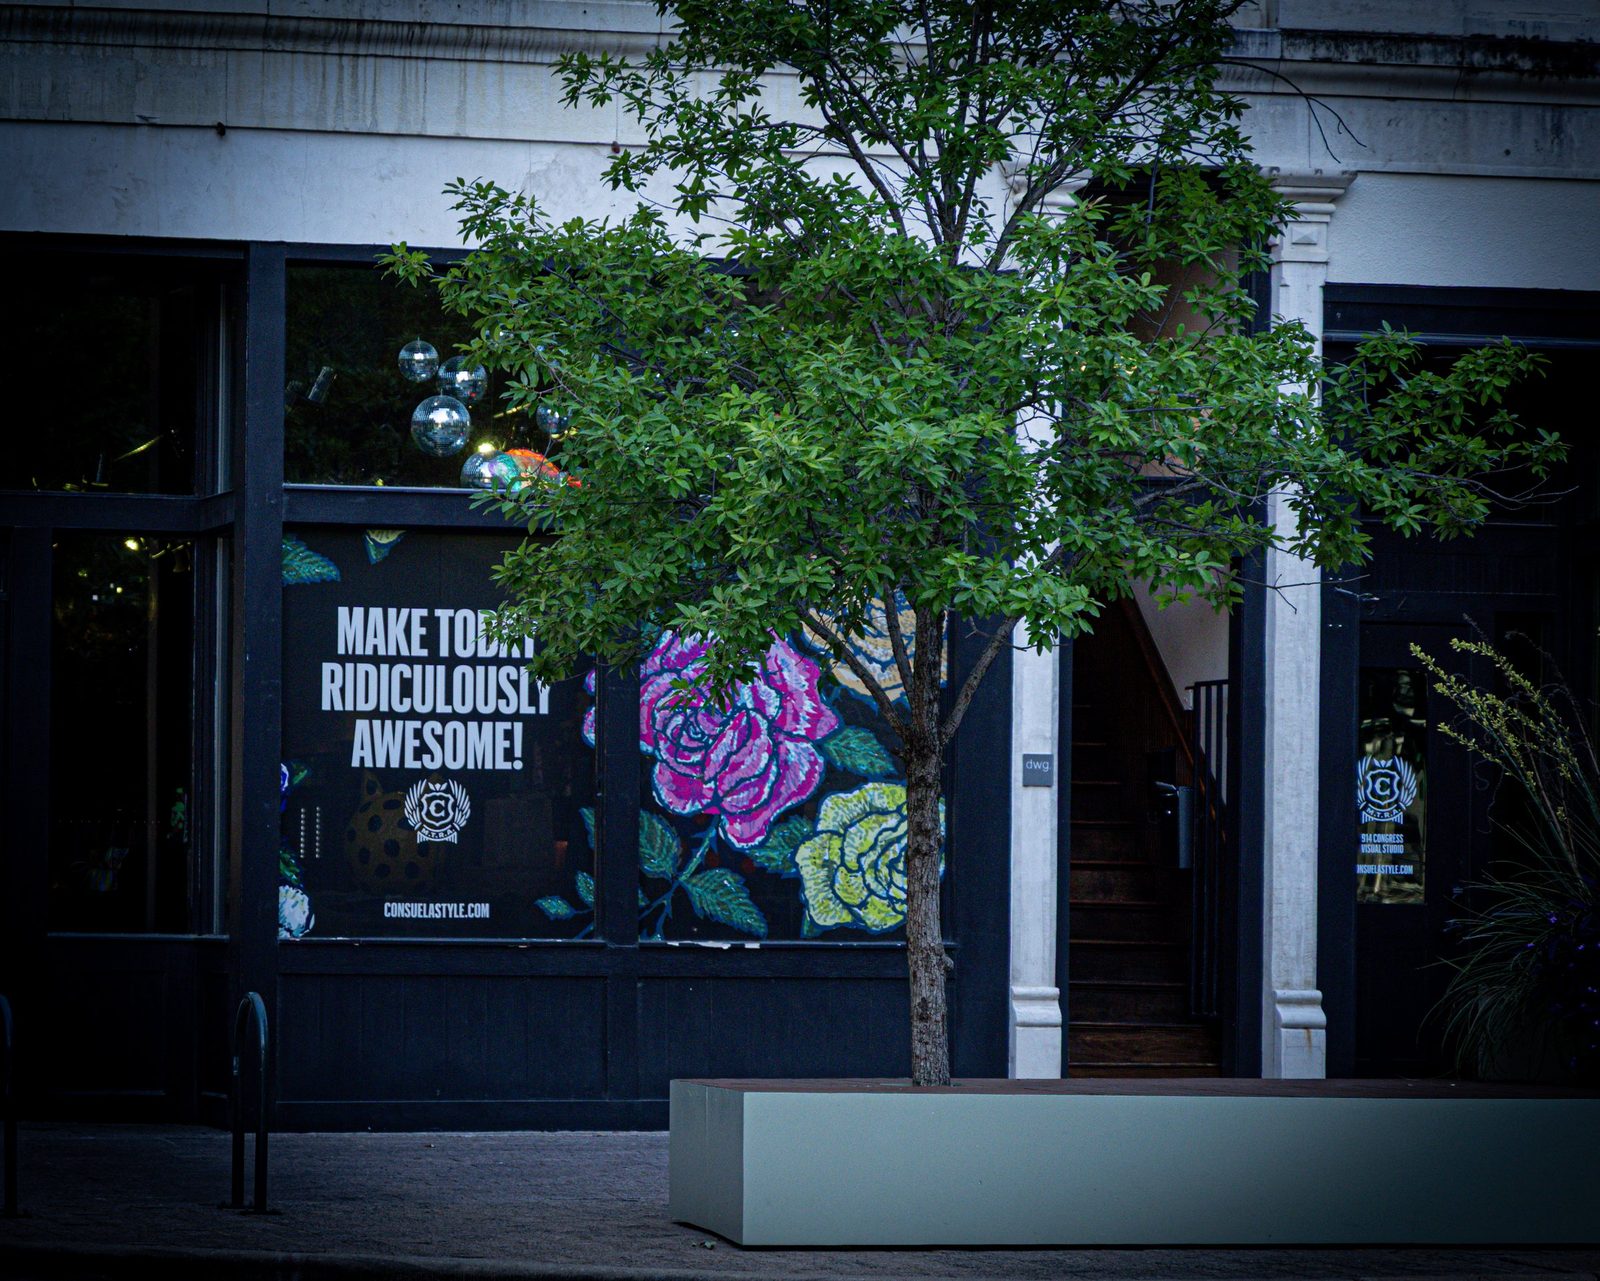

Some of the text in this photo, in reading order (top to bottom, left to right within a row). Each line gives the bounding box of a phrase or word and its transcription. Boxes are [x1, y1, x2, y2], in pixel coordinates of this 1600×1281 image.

[337, 606, 428, 657] MAKE
[321, 662, 550, 714] RIDICULOUSLY
[351, 719, 523, 771] AWESOME!
[1374, 777, 1390, 795] C
[428, 799, 446, 817] C
[1361, 833, 1404, 844] 914 CONGRESS
[1361, 844, 1405, 855] VISUAL STUDIO
[383, 902, 490, 918] CONSUELASTYLE.COM
